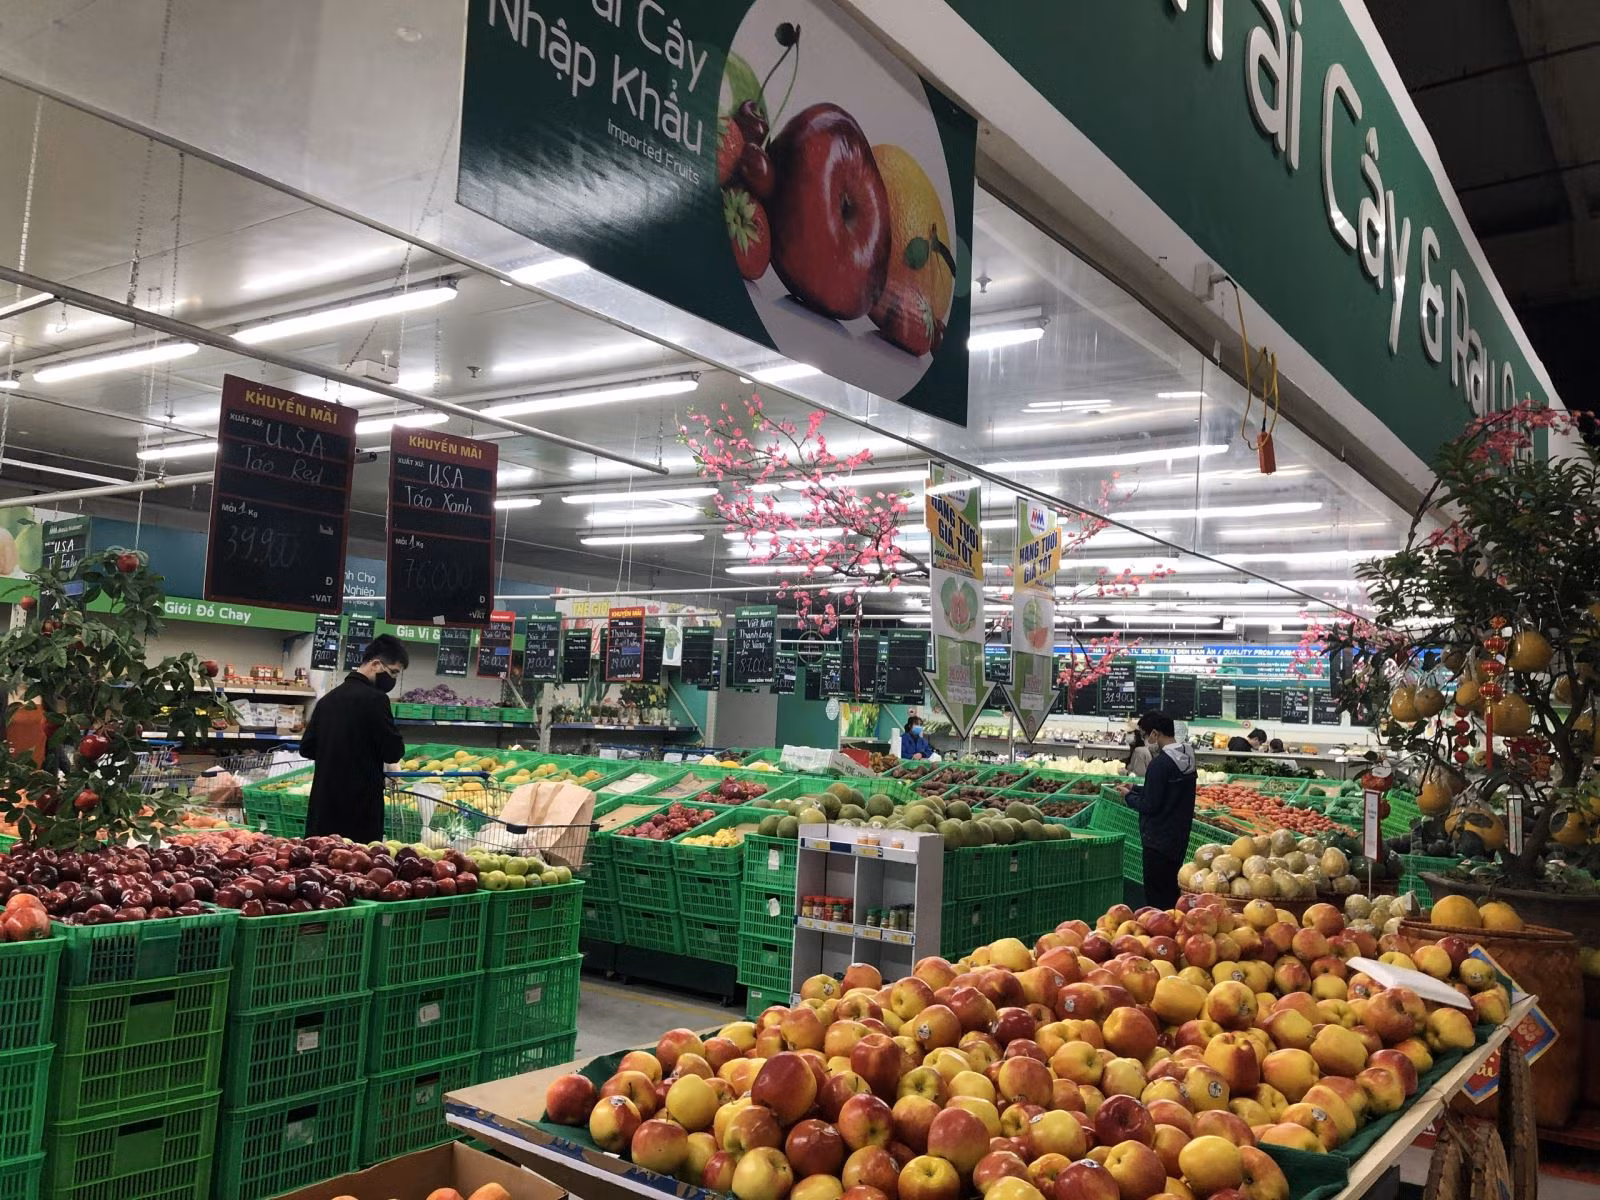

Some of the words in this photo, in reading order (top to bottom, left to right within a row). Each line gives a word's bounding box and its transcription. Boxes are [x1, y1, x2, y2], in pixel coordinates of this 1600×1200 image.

[637, 2, 708, 92] Cây
[487, 0, 596, 97] Nhập
[612, 55, 701, 154] Khẩu
[607, 119, 662, 163] Imported
[665, 153, 700, 185] Fruits
[1321, 63, 1410, 355] Cây
[1419, 226, 1444, 363] &
[245, 389, 306, 417] KHUYẾN
[408, 434, 458, 455] KHUYẾN
[241, 444, 275, 473] Táo
[290, 458, 324, 485] Red
[404, 485, 432, 509] Táo
[442, 493, 473, 514] Xanh
[938, 518, 954, 549] GIÁ
[956, 536, 973, 567] TỐT
[958, 515, 979, 552] TƯƠI
[1019, 541, 1039, 566] HÀNG
[1041, 530, 1058, 554] TƯƠI
[357, 571, 376, 584] Cho
[1024, 562, 1036, 584] GIÁ
[1038, 554, 1052, 575] TỐT
[343, 583, 375, 597] Nghiệp
[165, 601, 191, 616] Giới
[219, 607, 252, 625] Chay
[396, 625, 415, 638] Gia
[417, 627, 430, 640] Vị
[739, 628, 758, 639] Thanh
[758, 629, 772, 644] Long
